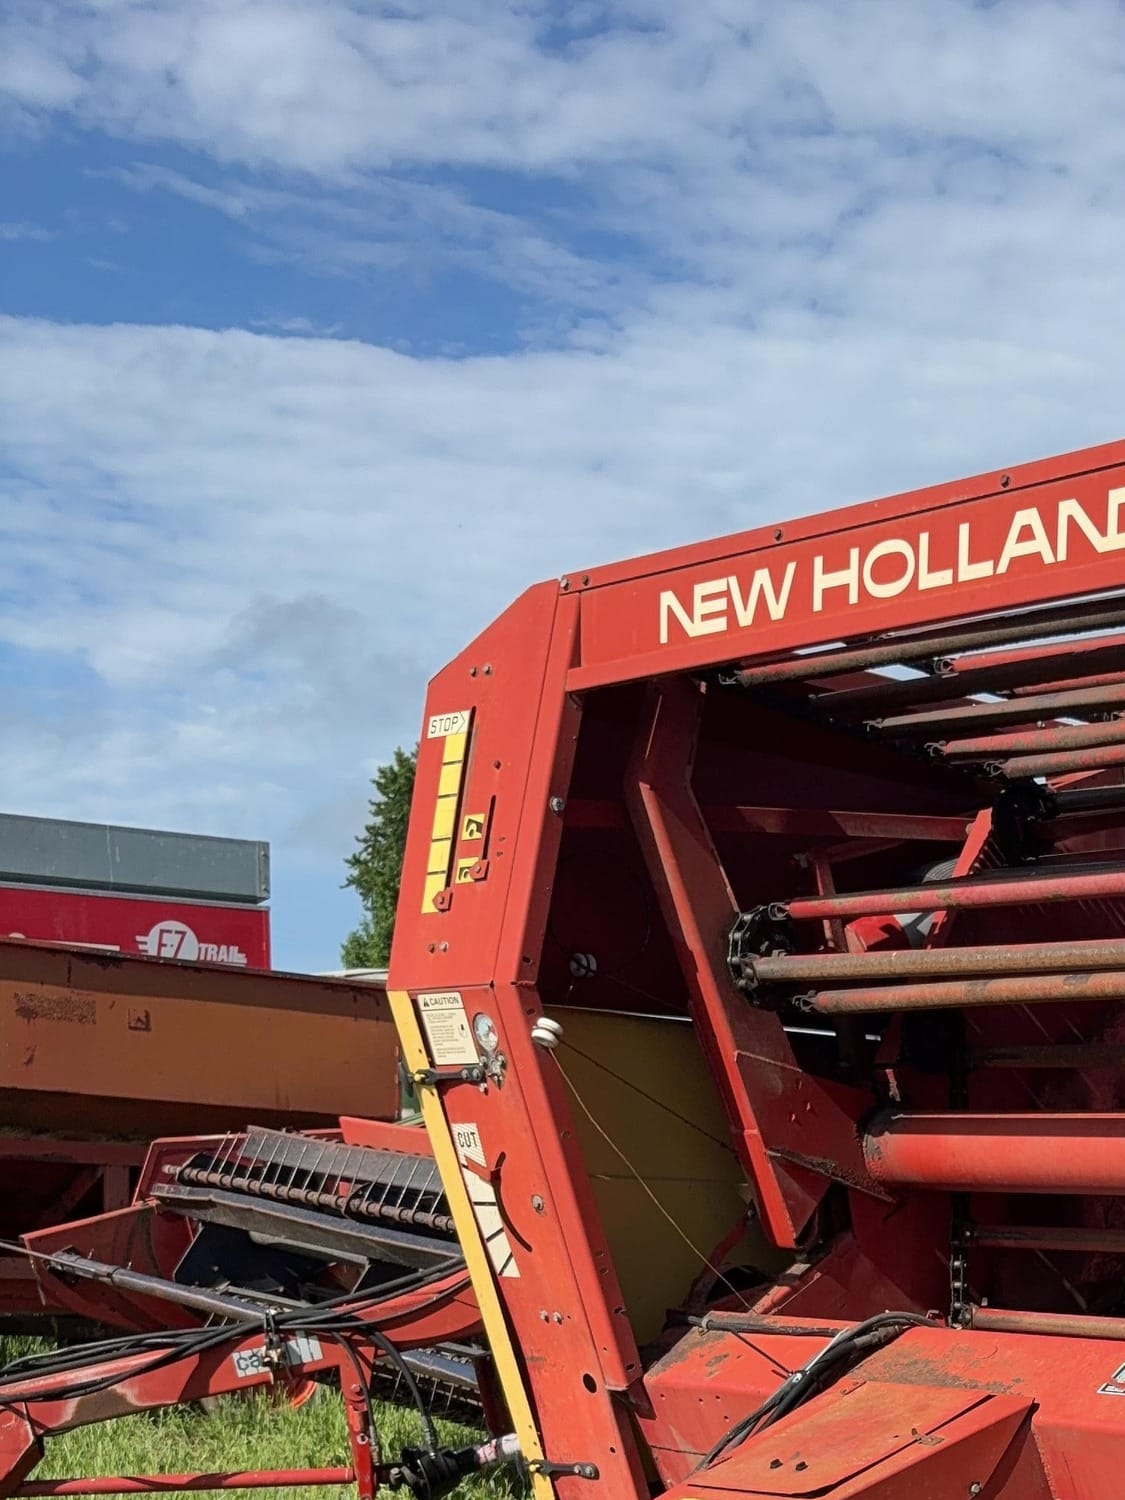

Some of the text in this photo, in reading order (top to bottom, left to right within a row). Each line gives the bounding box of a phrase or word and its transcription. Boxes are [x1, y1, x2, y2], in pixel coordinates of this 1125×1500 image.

[659, 561, 796, 644] NEW
[430, 715, 459, 735] STOP
[429, 995, 460, 1007] CAUTION
[457, 1131, 478, 1148] CUT
